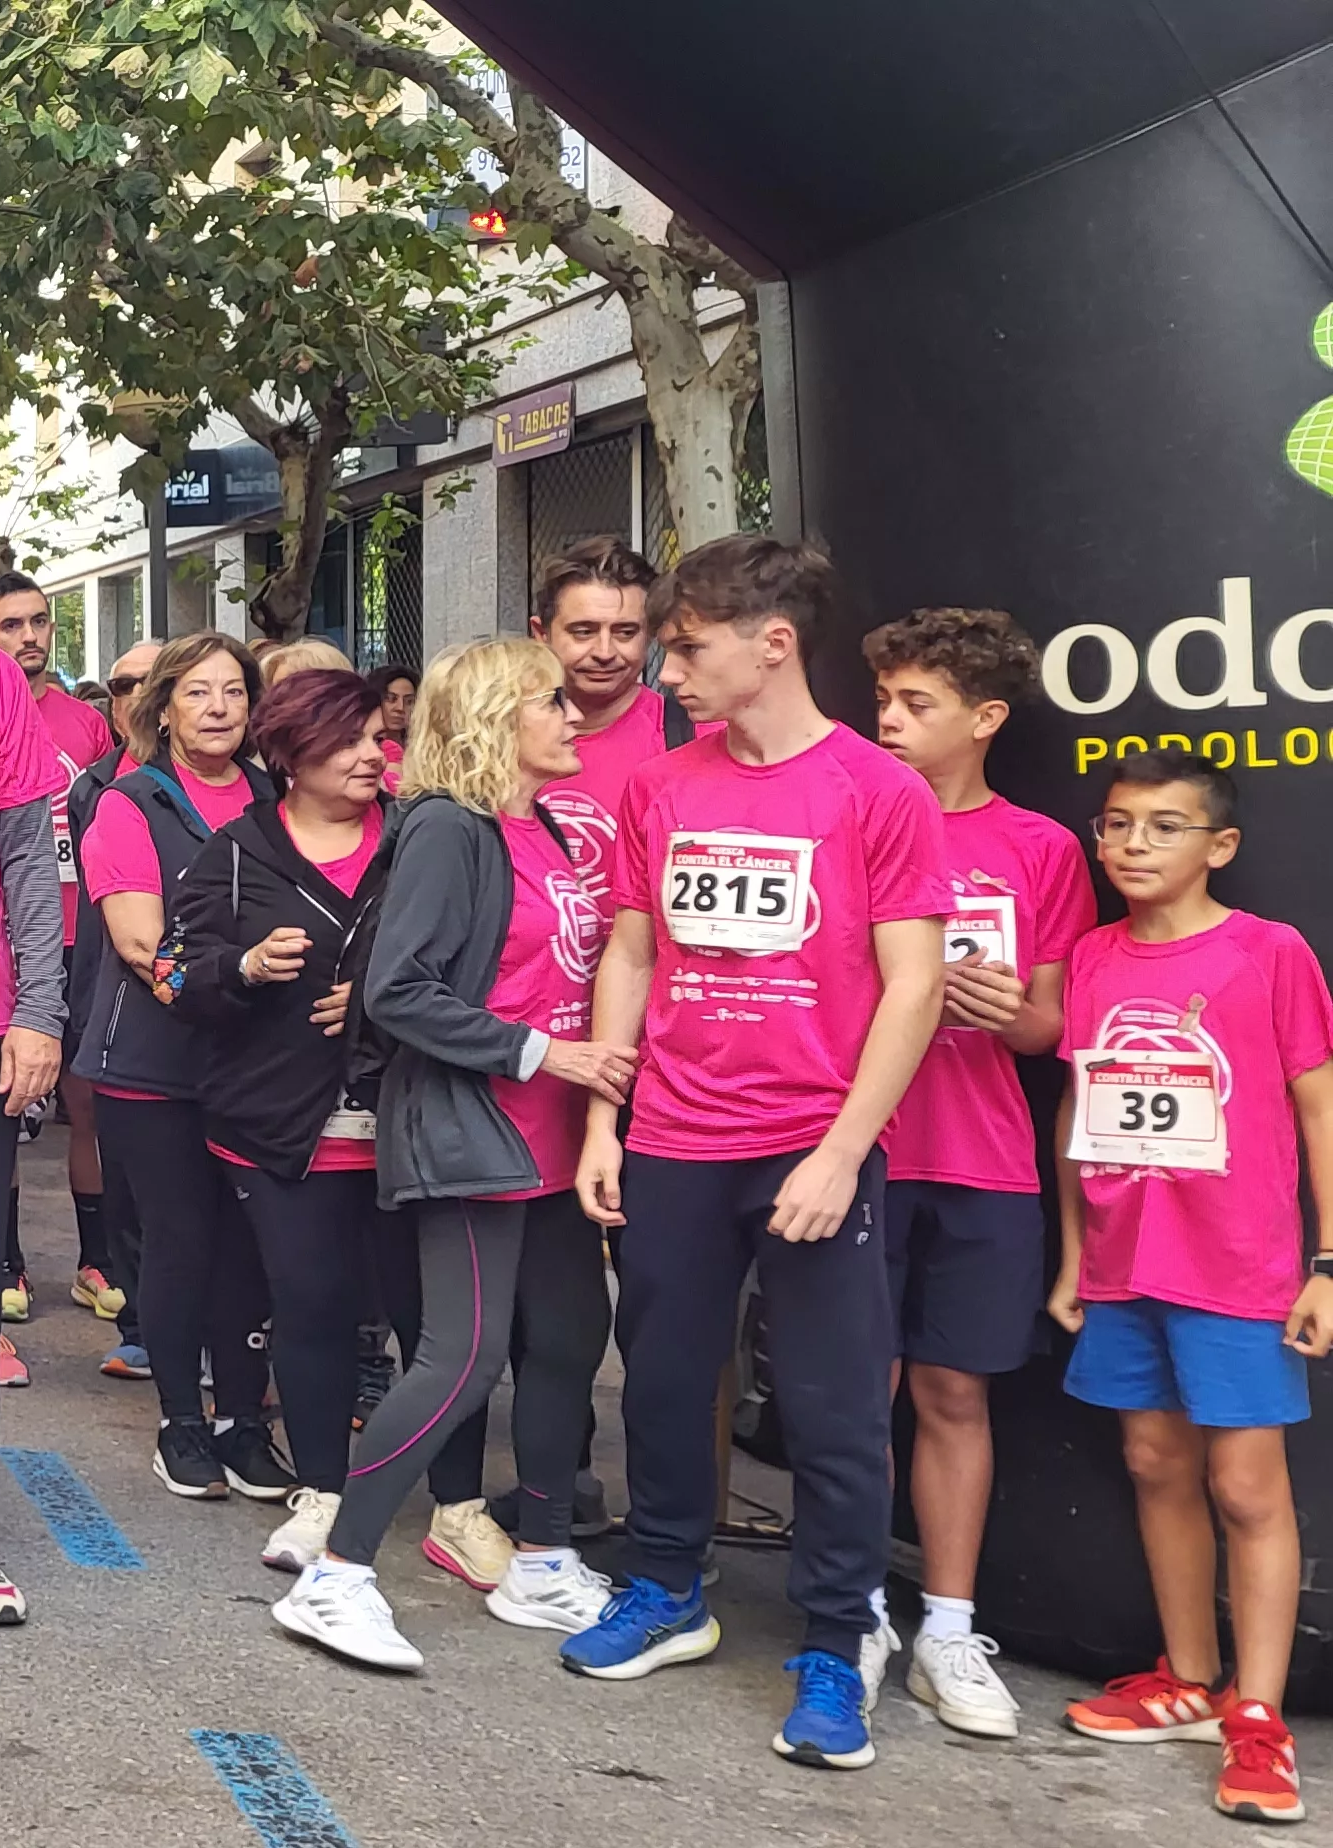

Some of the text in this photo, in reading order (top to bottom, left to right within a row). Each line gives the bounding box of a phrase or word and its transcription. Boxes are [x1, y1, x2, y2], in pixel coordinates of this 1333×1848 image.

[518, 401, 570, 437] TABACOS
[1075, 726, 1333, 775] PODOLO
[717, 855, 733, 867] EL
[735, 854, 792, 871] CÁNCER
[671, 871, 788, 917] 2815
[944, 916, 996, 931] ÁNCER
[1119, 1091, 1180, 1133] 39
